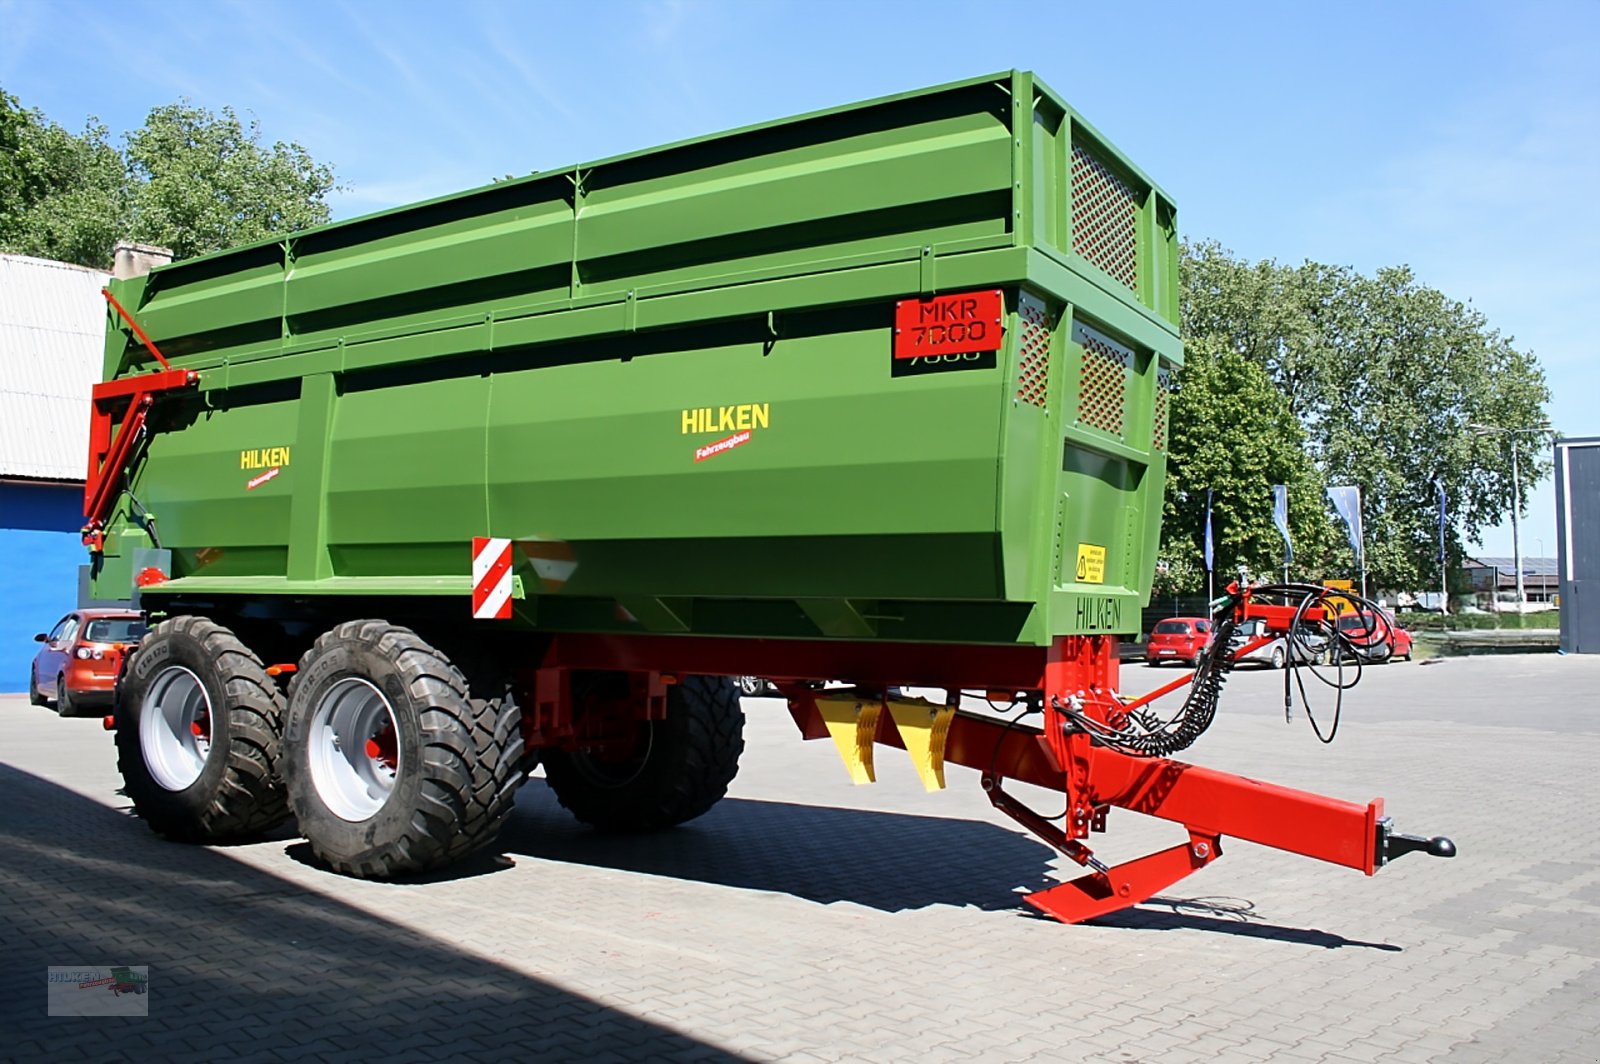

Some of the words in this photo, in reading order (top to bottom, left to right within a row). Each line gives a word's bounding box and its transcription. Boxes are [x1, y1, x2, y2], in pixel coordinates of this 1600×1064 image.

[919, 298, 978, 324] MKR
[910, 320, 986, 346] 7000
[681, 403, 769, 434] HILKEN
[240, 446, 290, 469] HILKEN
[695, 431, 750, 460] Fahrzeugbau
[1075, 597, 1121, 630] HILKEN
